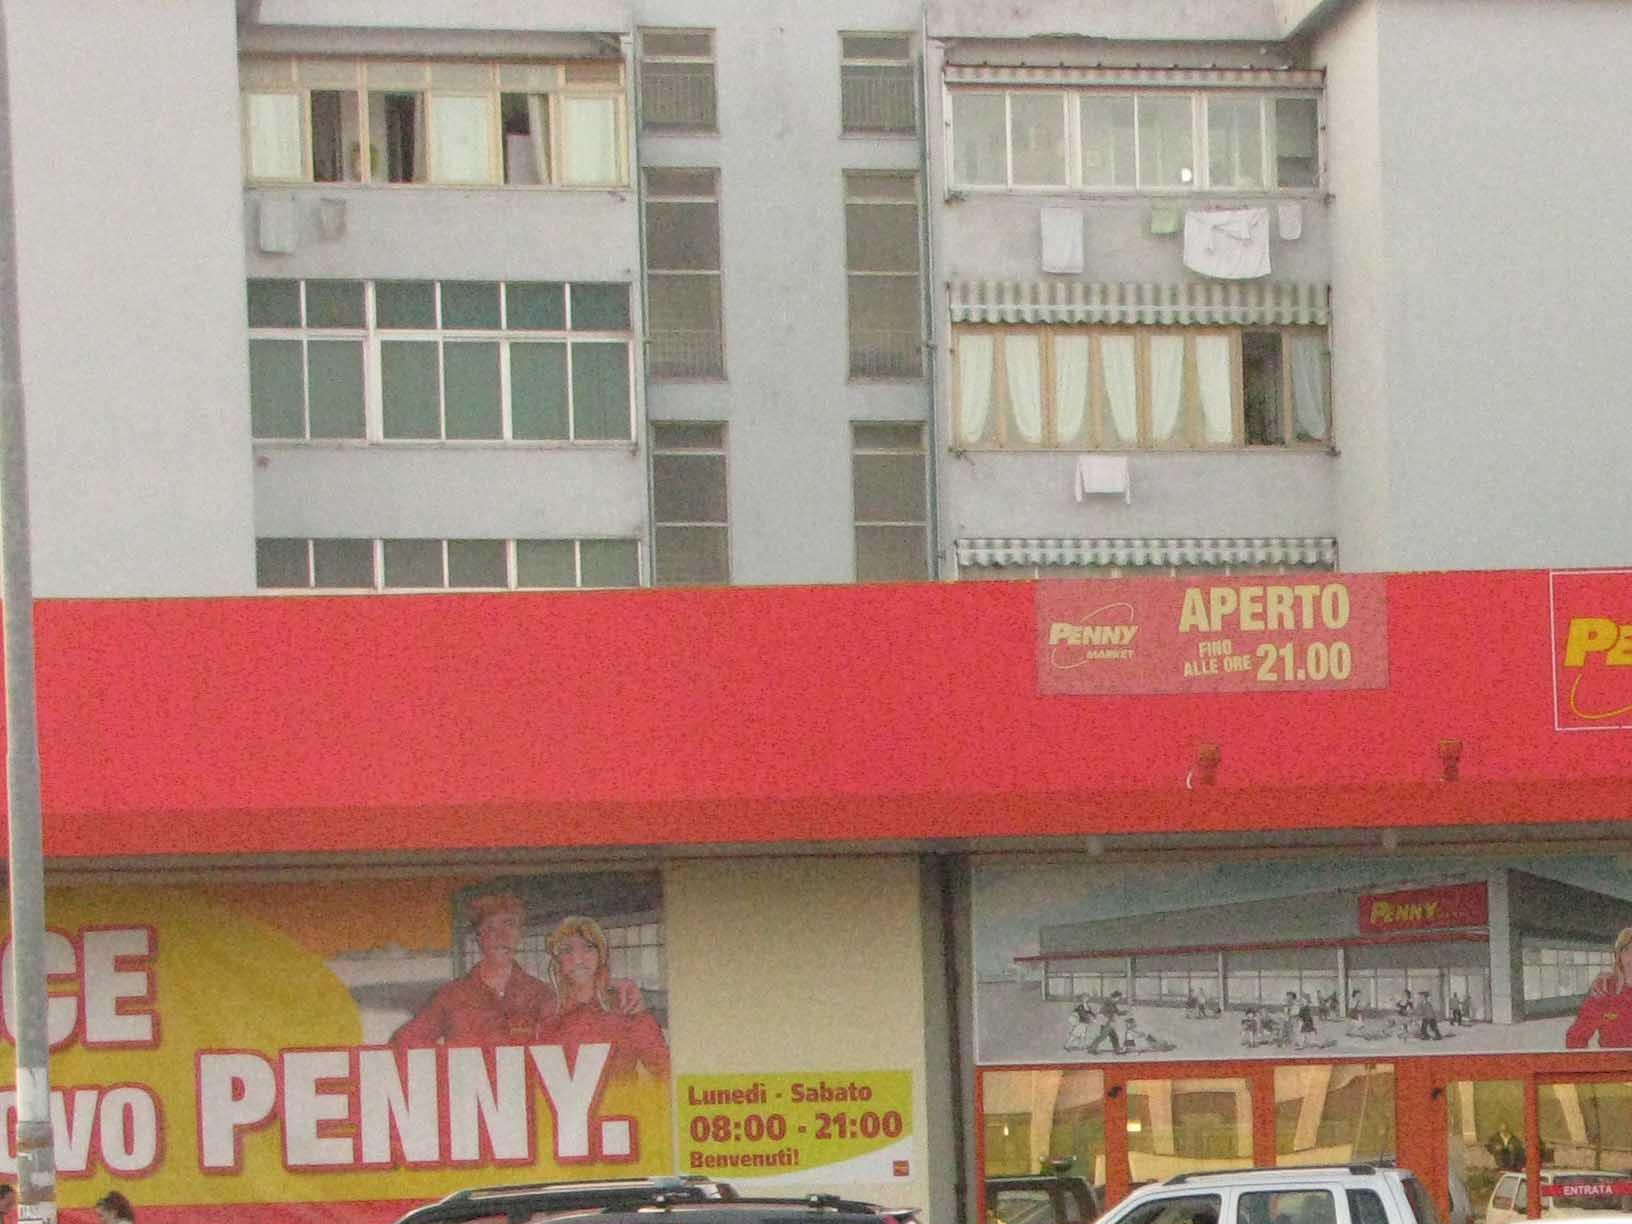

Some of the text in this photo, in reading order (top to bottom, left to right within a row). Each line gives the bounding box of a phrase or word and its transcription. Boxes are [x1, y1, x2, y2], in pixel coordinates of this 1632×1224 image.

[1178, 583, 1351, 632] APERTO
[1048, 622, 1139, 646] PENNY
[1199, 639, 1232, 657] FINO
[1184, 642, 1351, 682] ALLE ORE 21.00
[1370, 900, 1440, 925] PENNY
[790, 1081, 873, 1104] Sabato
[202, 1044, 632, 1168] PENNY.
[690, 1114, 787, 1143] 08:00
[815, 1111, 904, 1140] 21:00
[690, 1149, 800, 1169] Benvenuti!
[1563, 1184, 1613, 1196] ENTRATA
